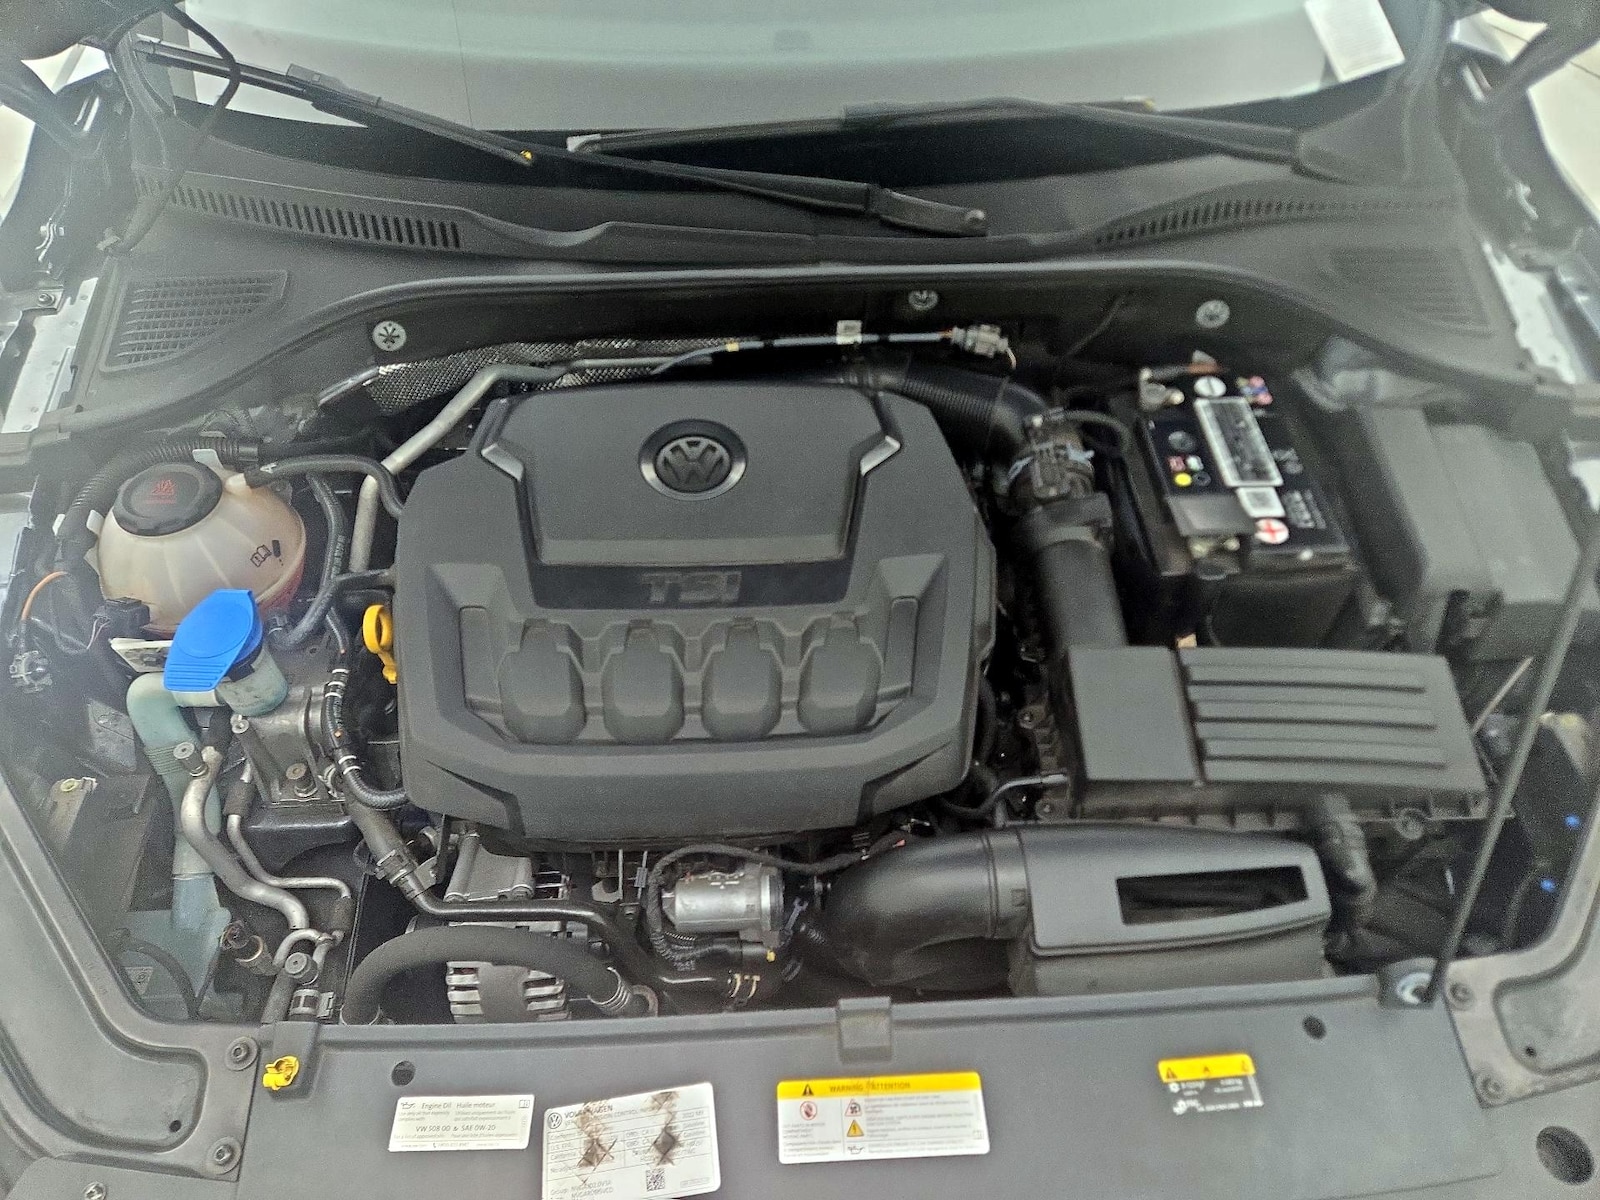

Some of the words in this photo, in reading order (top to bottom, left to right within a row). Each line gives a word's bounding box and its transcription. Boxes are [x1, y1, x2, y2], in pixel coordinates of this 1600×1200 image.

[641, 571, 742, 603] TSI
[829, 1082, 864, 1093] WARNING
[421, 1102, 442, 1111] Engine
[443, 1101, 452, 1109] Oil
[456, 1101, 472, 1109] Huile
[461, 1124, 473, 1132] SAE
